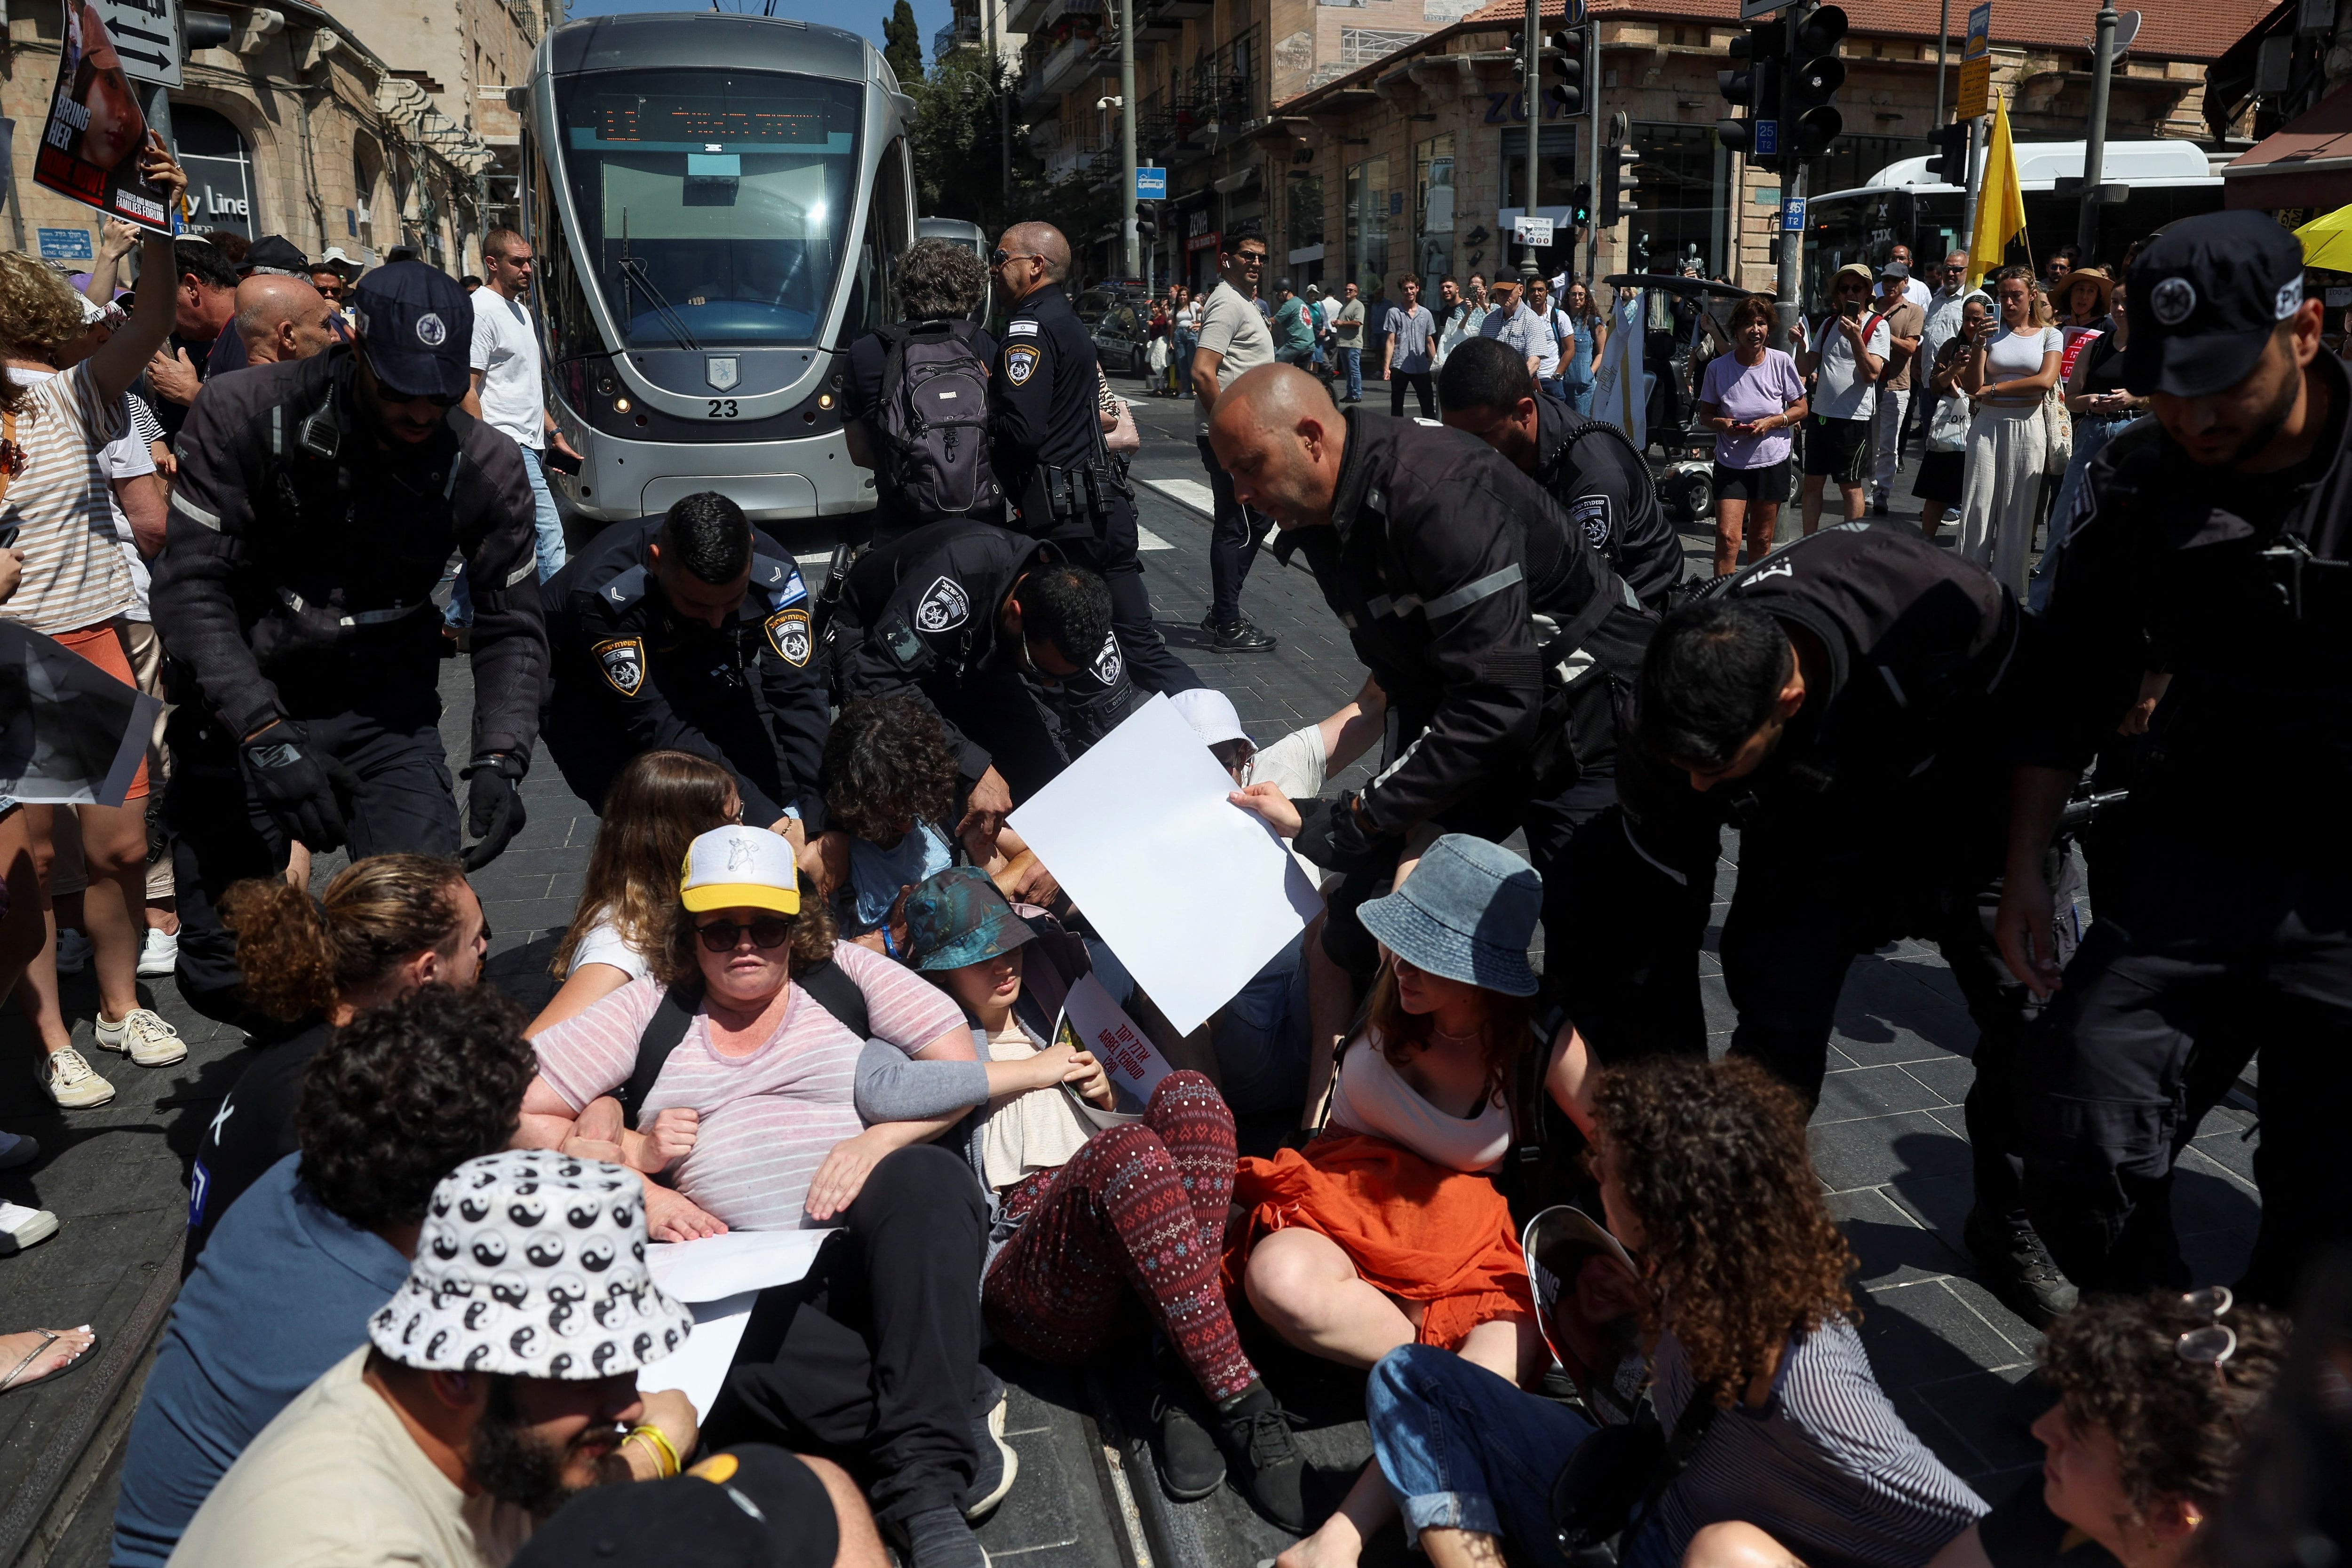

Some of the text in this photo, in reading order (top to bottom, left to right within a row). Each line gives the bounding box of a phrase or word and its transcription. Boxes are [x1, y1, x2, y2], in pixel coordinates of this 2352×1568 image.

[55, 95, 91, 132] BRING
[47, 120, 72, 150] HER
[1760, 126, 1773, 136] 25
[40, 146, 107, 197] HOME NOW!
[116, 196, 165, 222] FAMILIES FORUM
[117, 188, 136, 202] HOSTAGES
[145, 199, 164, 212] MISSING
[205, 185, 248, 215] Line
[1189, 210, 1208, 237] ZOYA
[708, 399, 739, 418] 23
[942, 581, 968, 615] משטרת ישראל
[769, 617, 787, 629] ישראל
[1097, 1029, 1146, 1081] ARBEL YEHOUD
[1115, 1023, 1151, 1064] ארבל יהוד
[1102, 1054, 1120, 1077] (28)
[1527, 1252, 1560, 1305] BRING
